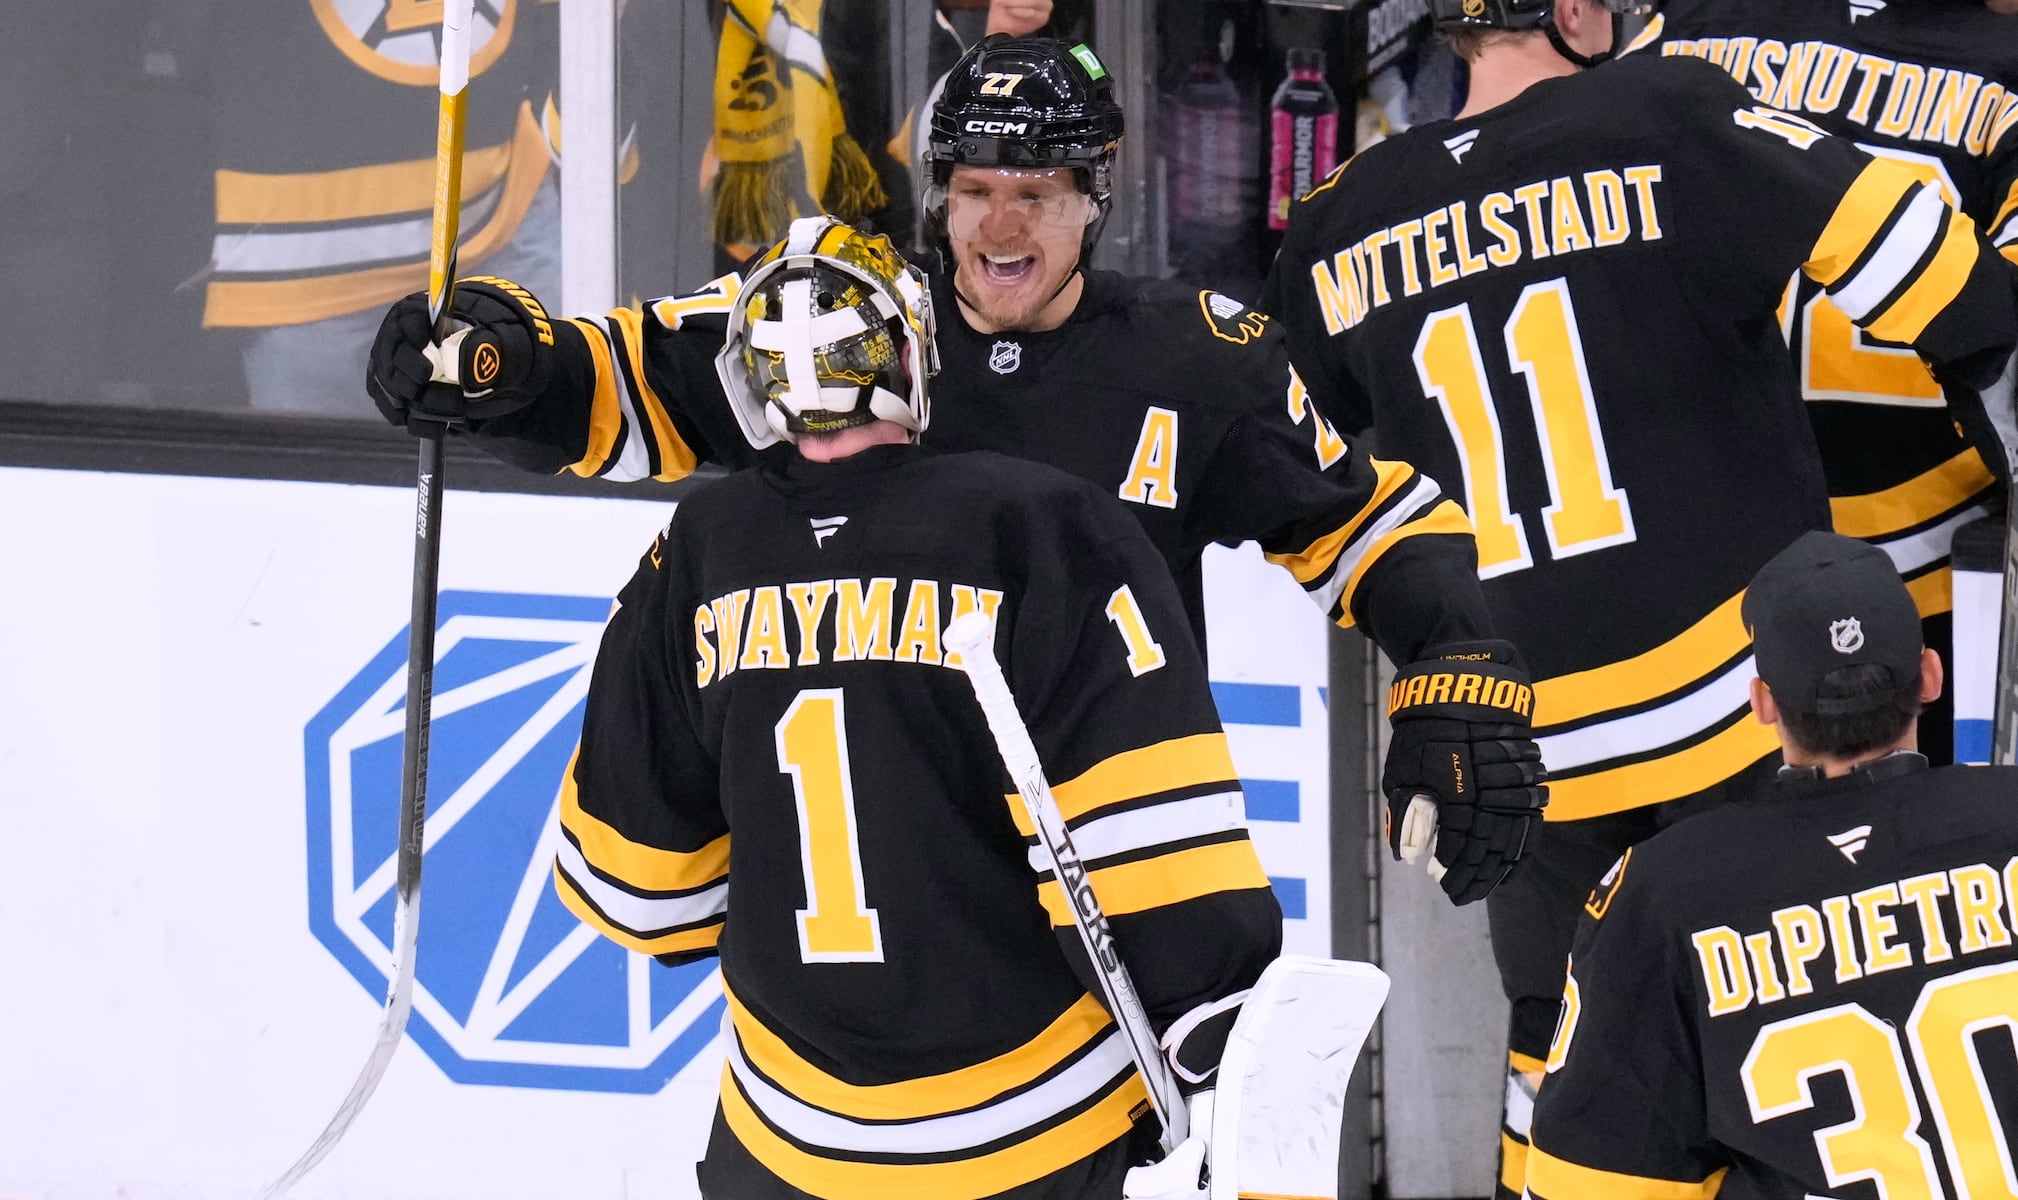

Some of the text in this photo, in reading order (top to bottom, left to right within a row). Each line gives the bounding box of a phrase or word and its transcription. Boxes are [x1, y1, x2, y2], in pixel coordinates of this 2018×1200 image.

[964, 120, 1028, 135] CCM
[980, 72, 1024, 96] 27
[1661, 37, 2018, 157] USNUTDINOV
[1311, 164, 1663, 337] MITTELSTADT
[1118, 405, 1179, 510] A
[1412, 276, 1637, 581] 11
[417, 480, 430, 539] BAUER
[694, 577, 1004, 689] SWAYMAN
[1104, 583, 1167, 679] 1
[1388, 673, 1533, 717] WARRIOR
[774, 687, 885, 964] 1
[1451, 752, 1465, 794] ALPHA
[1056, 826, 1120, 973] TACKS
